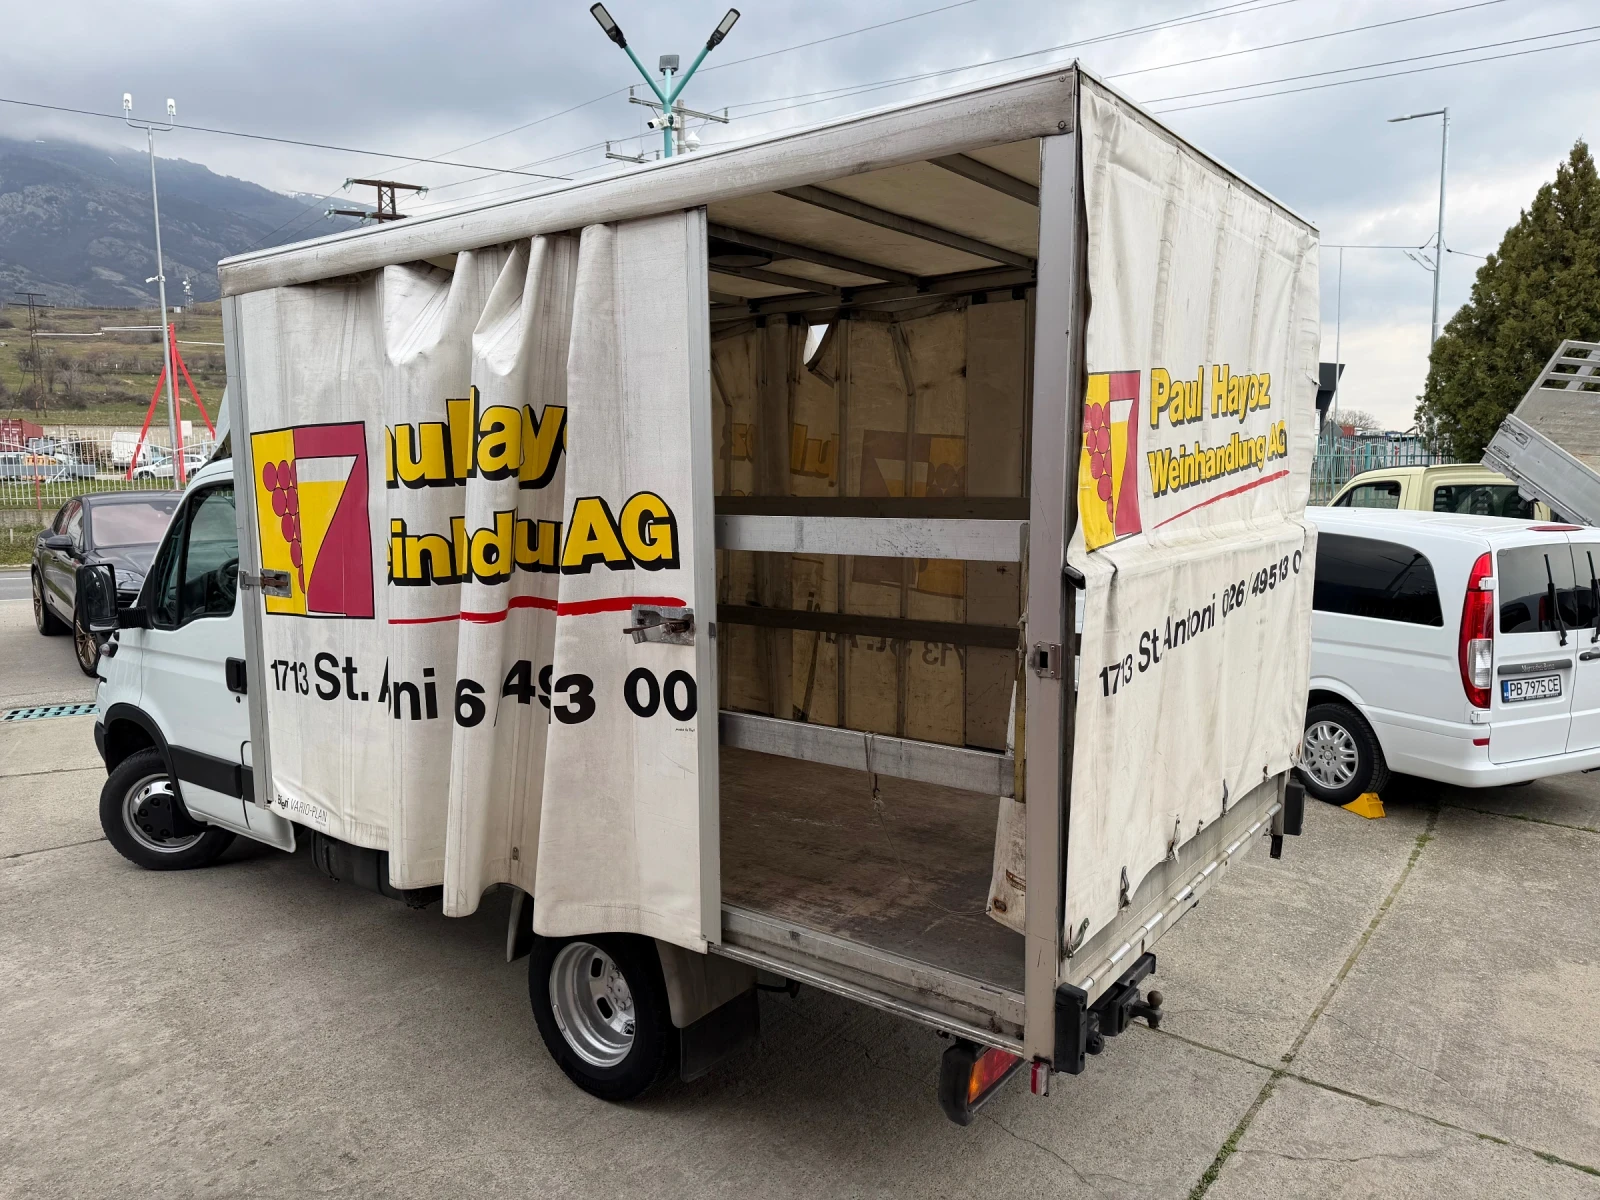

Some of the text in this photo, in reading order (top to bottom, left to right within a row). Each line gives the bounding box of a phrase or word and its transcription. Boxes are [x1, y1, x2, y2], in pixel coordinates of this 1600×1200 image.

[1150, 363, 1271, 430] Paul Hayoz
[1147, 420, 1288, 498] Weinhandlung AG
[561, 490, 680, 576] AG
[270, 659, 309, 696] 1713
[314, 652, 369, 702] St.
[623, 667, 698, 722] 00
[1099, 653, 1133, 697] 1713
[1509, 678, 1560, 697] PB 7975 CE
